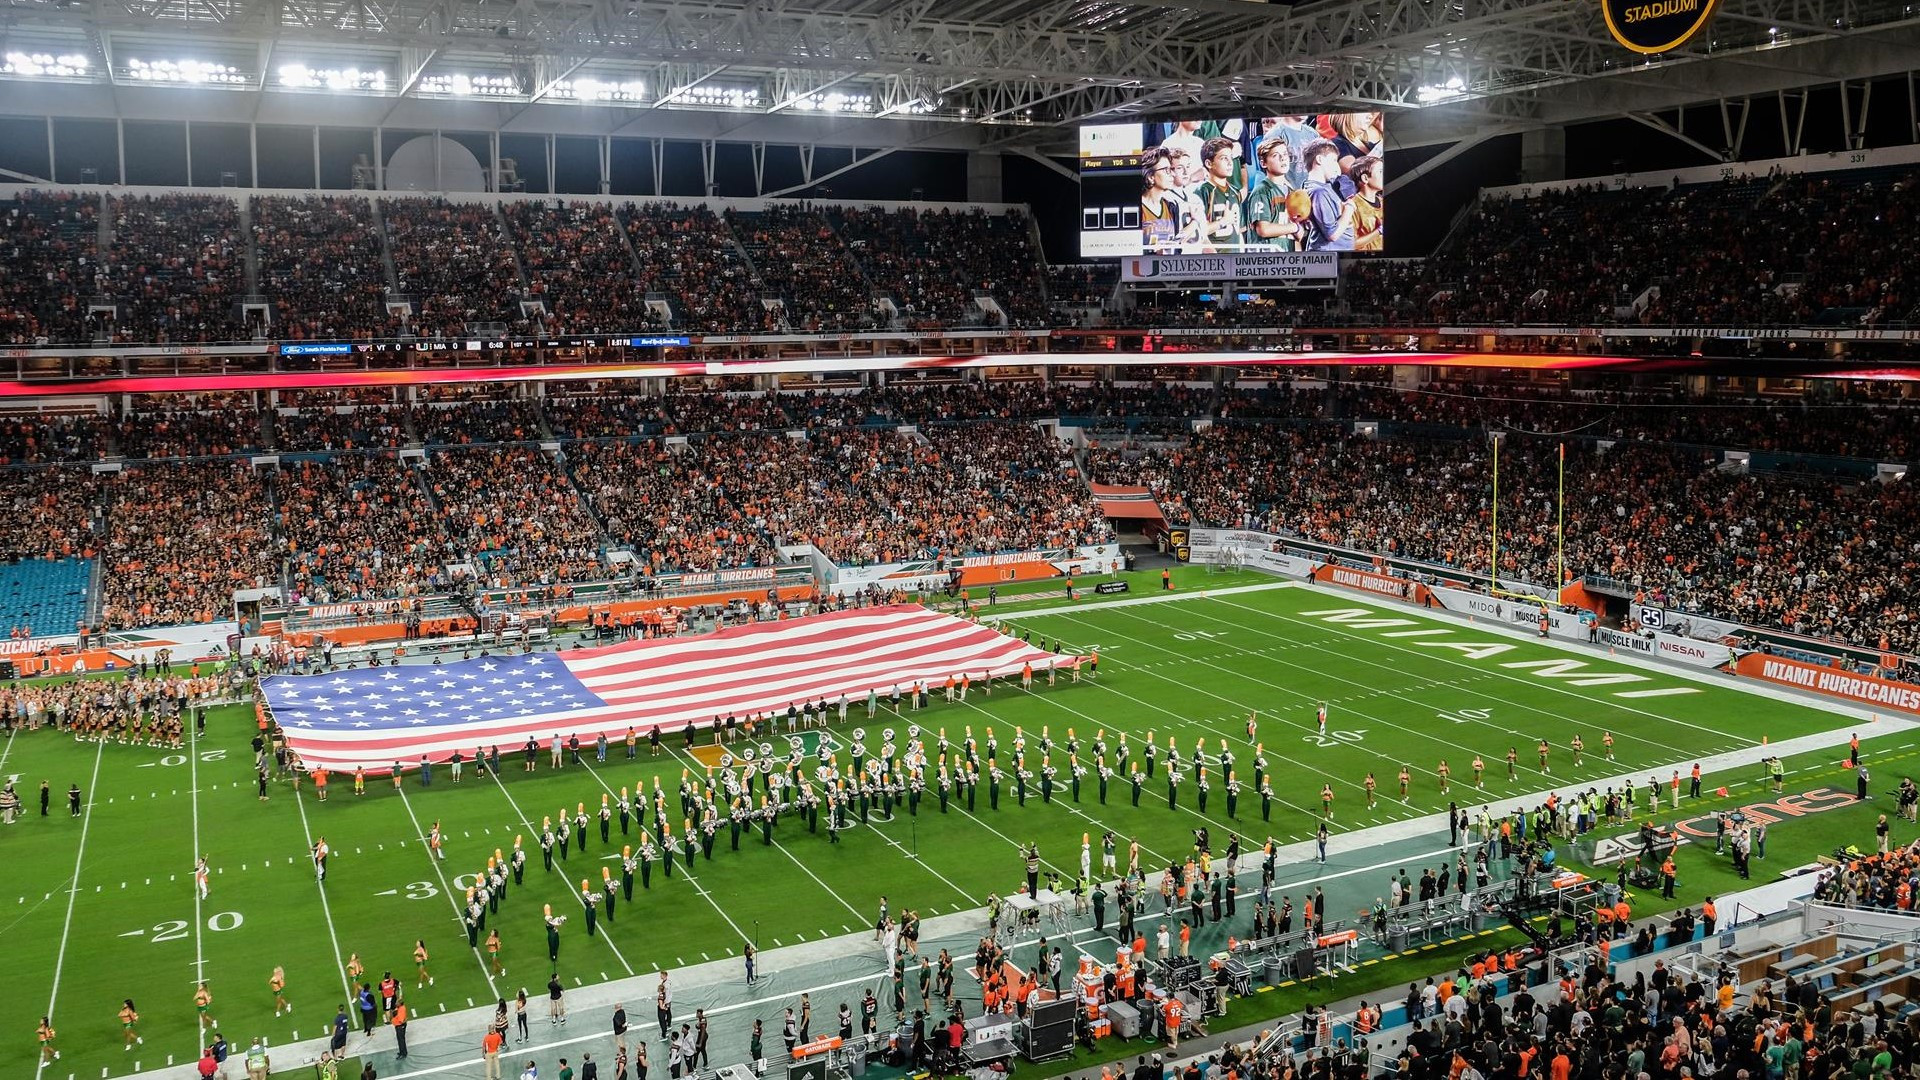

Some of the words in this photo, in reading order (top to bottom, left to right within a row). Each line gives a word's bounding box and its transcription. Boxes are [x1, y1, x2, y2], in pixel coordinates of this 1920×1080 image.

[1624, 0, 1698, 23] STADIUM
[1850, 154, 1866, 163] 331
[1160, 259, 1226, 273] SYLVESTER
[1235, 256, 1287, 266] UNIVERSITY
[1288, 255, 1301, 265] OF
[1302, 255, 1333, 264] MIAMI
[1235, 267, 1269, 277] HEALTH
[1271, 266, 1306, 276] SYSTEM
[1671, 328, 1721, 337] NATIONAL
[1726, 329, 1790, 338] CHAMPIONS
[433, 342, 447, 350] MIA
[963, 555, 992, 568] MIAMI
[992, 551, 1043, 566] HURRICANES
[683, 573, 717, 585] MIAMI
[1332, 569, 1361, 587] MIAMI
[312, 604, 353, 618] MIAMI
[1469, 600, 1495, 613] MIDO
[1642, 609, 1660, 626] 25
[1601, 631, 1630, 648] MUSCLE
[1631, 638, 1651, 652] MILK
[1298, 607, 1704, 698] MIAMI
[1660, 641, 1705, 659] NISSAN
[1762, 660, 1818, 687] MIAMI
[1817, 671, 1920, 710] HURRICANES
[151, 911, 245, 943] 20
[1170, 1007, 1181, 1018] 92
